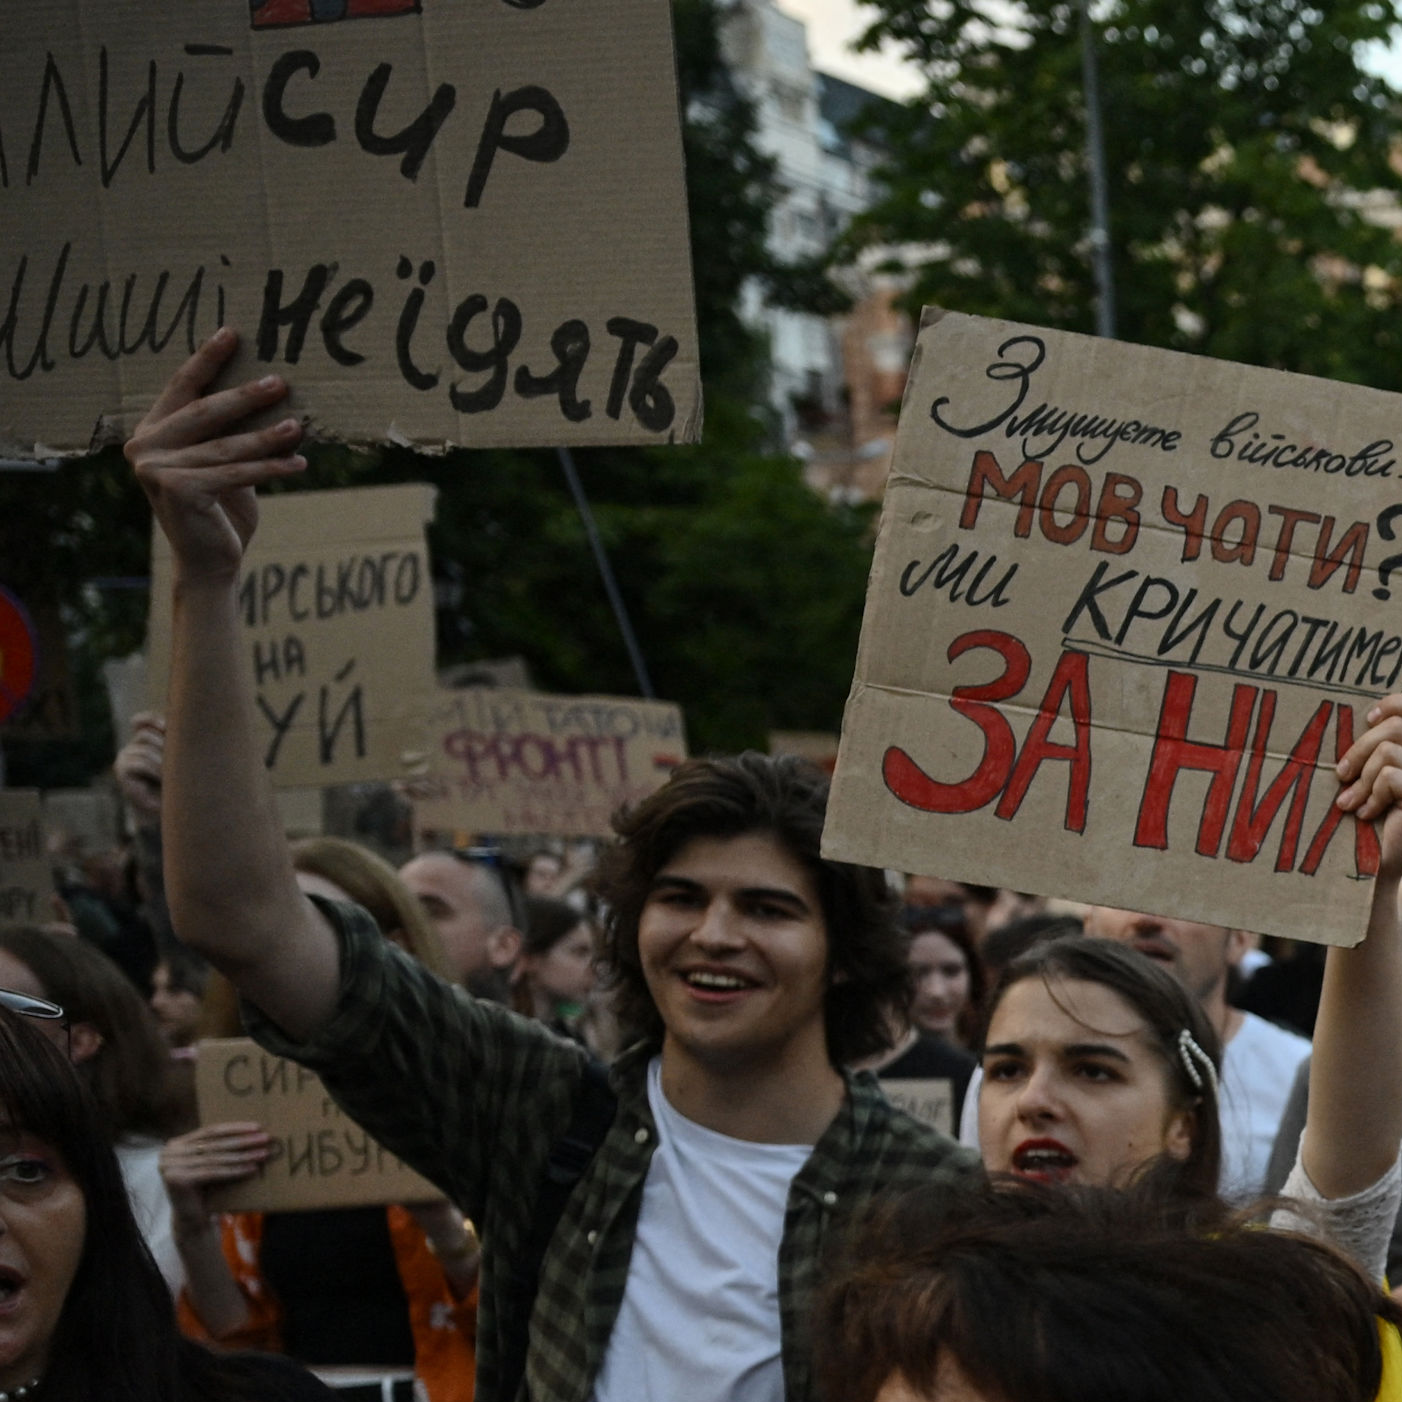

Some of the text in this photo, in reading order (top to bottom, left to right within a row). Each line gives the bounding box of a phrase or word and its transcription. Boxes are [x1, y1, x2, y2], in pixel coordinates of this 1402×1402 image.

[0, 44, 246, 189] ЛИЙ
[930, 335, 1183, 465] Змушуєте
[253, 635, 305, 686] НА
[882, 628, 1384, 881] ЗА НИХ
